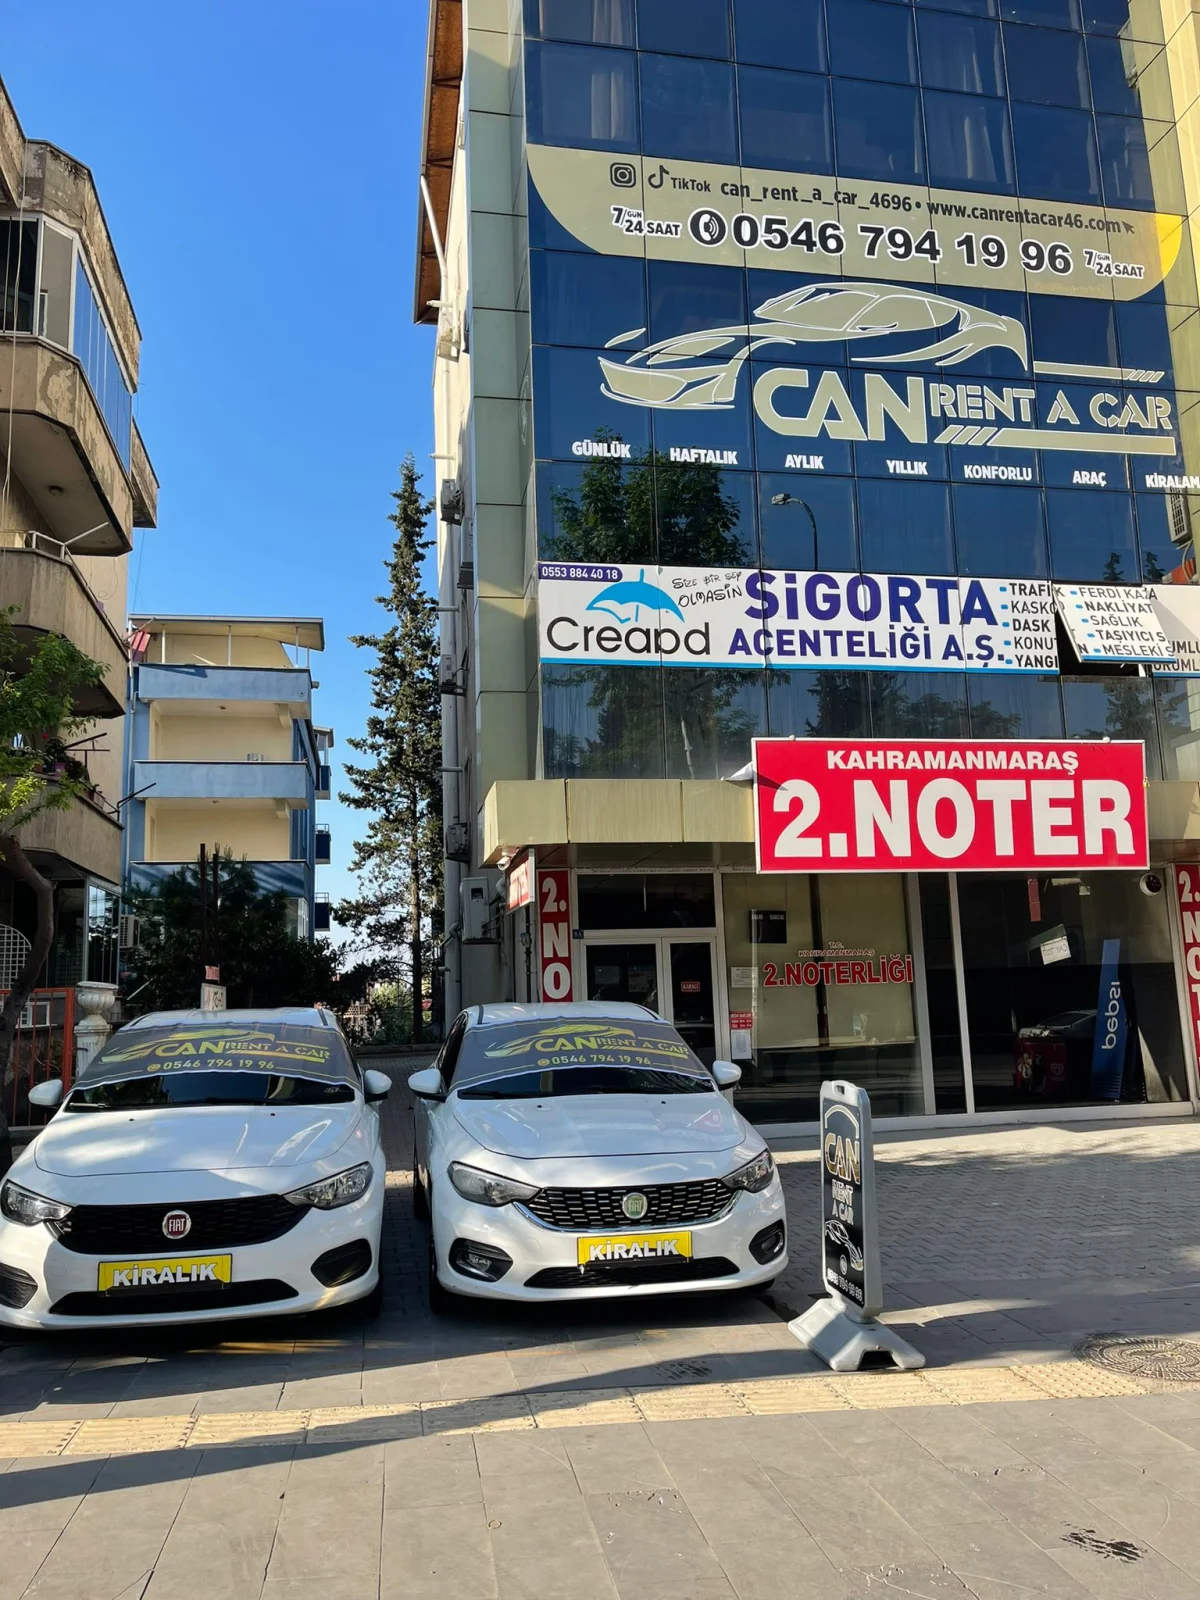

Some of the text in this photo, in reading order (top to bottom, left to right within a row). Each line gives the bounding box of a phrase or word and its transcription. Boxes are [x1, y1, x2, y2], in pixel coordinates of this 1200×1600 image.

[671, 177, 711, 193] TikTok
[926, 200, 1121, 233] www.canrentacar46.com
[646, 221, 681, 236] SAAT
[734, 215, 1073, 274] 0546 794 19 96
[1114, 264, 1143, 278] SAAT
[753, 367, 1173, 443] CAN RENT A CAR
[571, 439, 631, 459] GÜNLÜK
[669, 448, 738, 465] HAFTALIK
[784, 454, 824, 470] AYLIK
[886, 460, 928, 476] YILLIK
[963, 464, 1033, 481] KONFORLU
[1072, 470, 1107, 487] ARAÇ
[542, 566, 618, 580] 0553 884 40 18
[744, 571, 998, 626] SİGORTA
[1079, 585, 1121, 599] FERDİ
[1084, 600, 1153, 614] NAKLİYAT
[1012, 618, 1051, 632] DASK
[1090, 614, 1143, 628] SAĞLIK
[728, 624, 1005, 668] ACENTELİĞİ A.Ş.
[1102, 643, 1164, 657] MESLEKİ
[826, 750, 1079, 776] KAHRAMANMARAŞ
[772, 777, 1136, 859] 2.NOTER
[798, 948, 876, 957] KAHRAMANMARAŞ
[763, 954, 914, 988] 2.NOTERLİĞİ
[155, 1040, 330, 1059] CAN RENT A CAR
[535, 1036, 690, 1056] CAN RENT A CAR
[163, 1058, 274, 1070] 0546 794 19 96
[552, 1054, 651, 1065] 0546 794 19 96
[825, 1132, 860, 1185] CAN
[832, 1178, 854, 1206] RENT
[832, 1199, 839, 1218] A
[168, 1217, 186, 1233] FIAT
[588, 1238, 679, 1261] KİRALIK
[112, 1261, 218, 1287] KİRALIK
